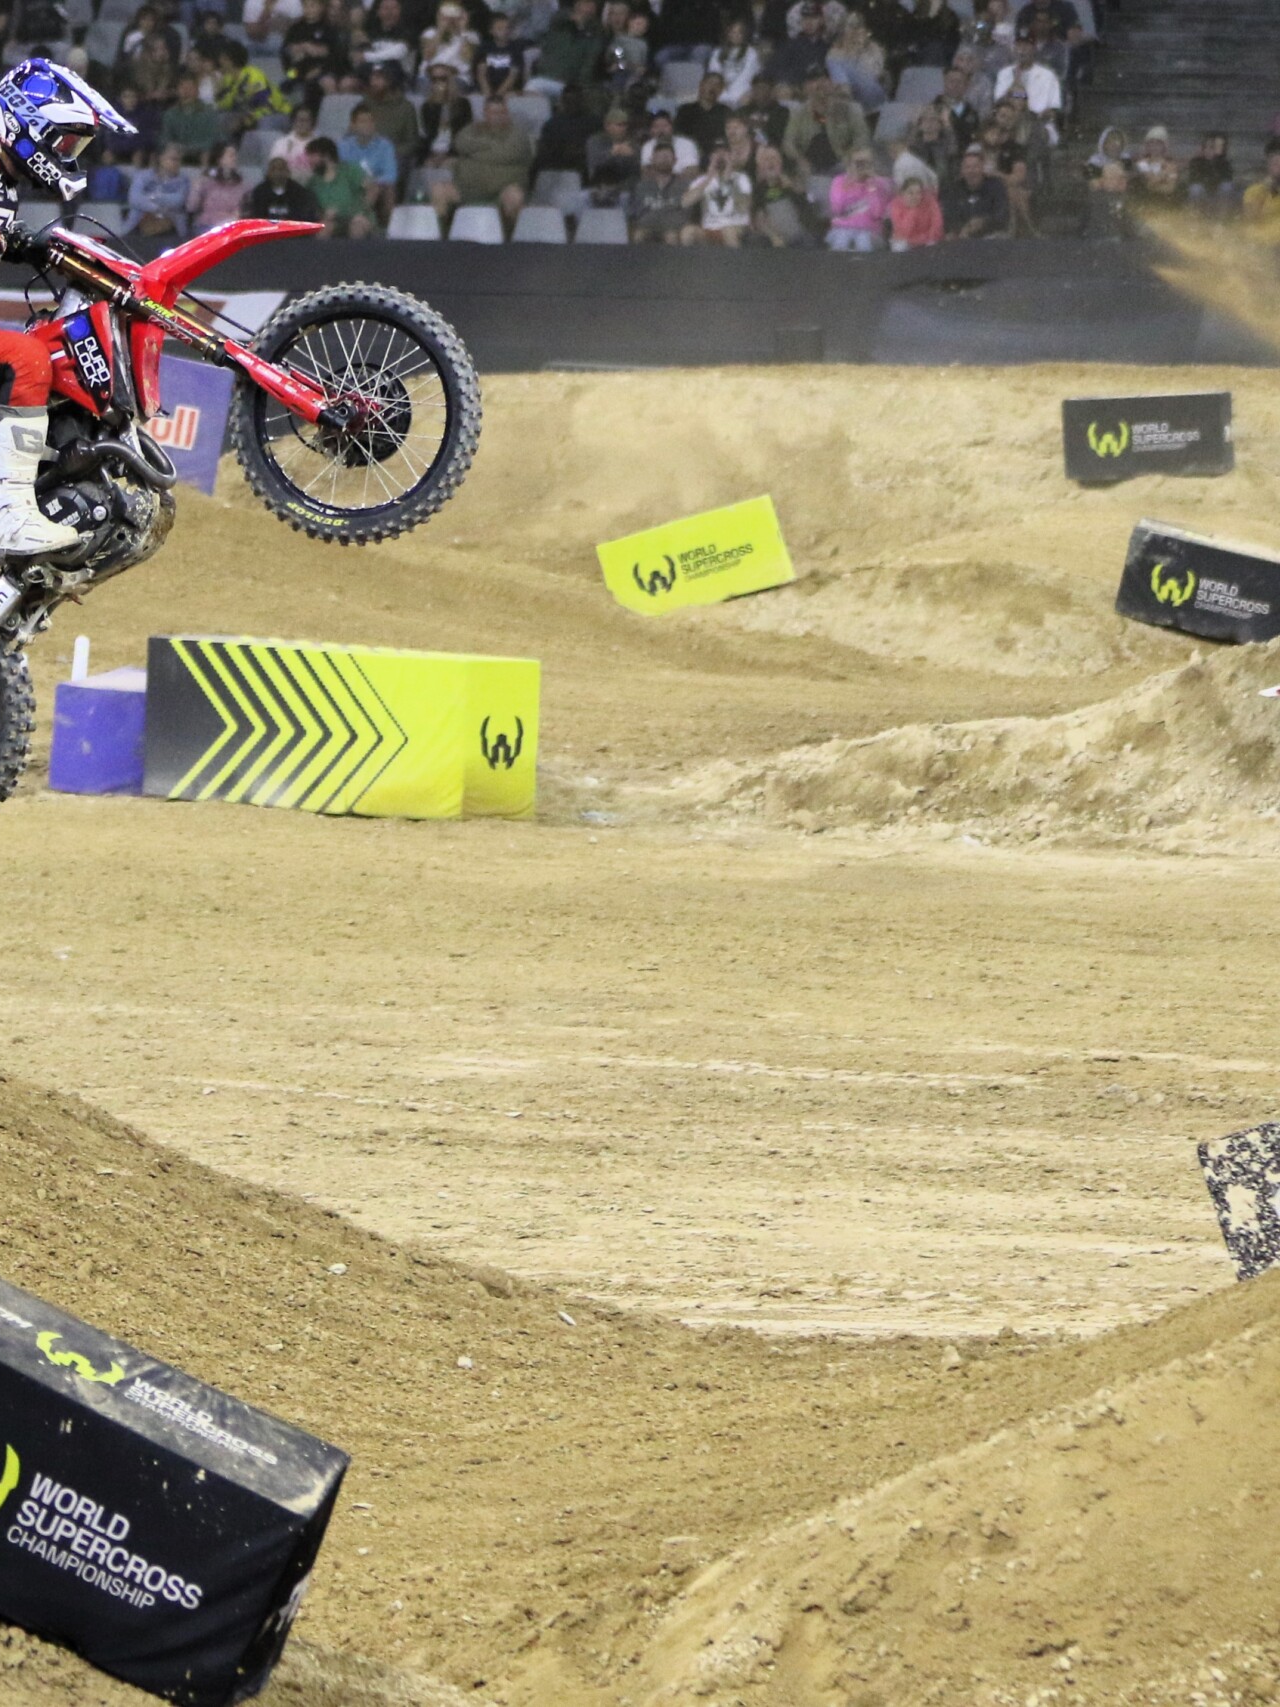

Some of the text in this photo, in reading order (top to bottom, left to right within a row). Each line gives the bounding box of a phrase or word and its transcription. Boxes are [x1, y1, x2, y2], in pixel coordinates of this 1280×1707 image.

[27, 157, 55, 185] LOCK
[33, 151, 62, 180] QUAD
[74, 341, 101, 388] LOCK
[84, 336, 111, 383] QUAD
[145, 405, 200, 450] ull
[1131, 423, 1169, 435] WORLD
[1131, 429, 1201, 446] SUPERCROSS
[287, 502, 344, 526] DUNLOP
[677, 544, 717, 564] WORLD
[680, 543, 754, 575] SUPERCROSS
[1196, 590, 1270, 615] SUPERCROSS
[1199, 578, 1238, 597] WORLD
[132, 1377, 214, 1423] WORLD
[128, 1385, 278, 1465] SUPERCROSS
[29, 1472, 130, 1541] WORLD
[6, 1526, 156, 1609] CHAMPIONSHIP
[16, 1500, 203, 1610] SUPERCROSS
